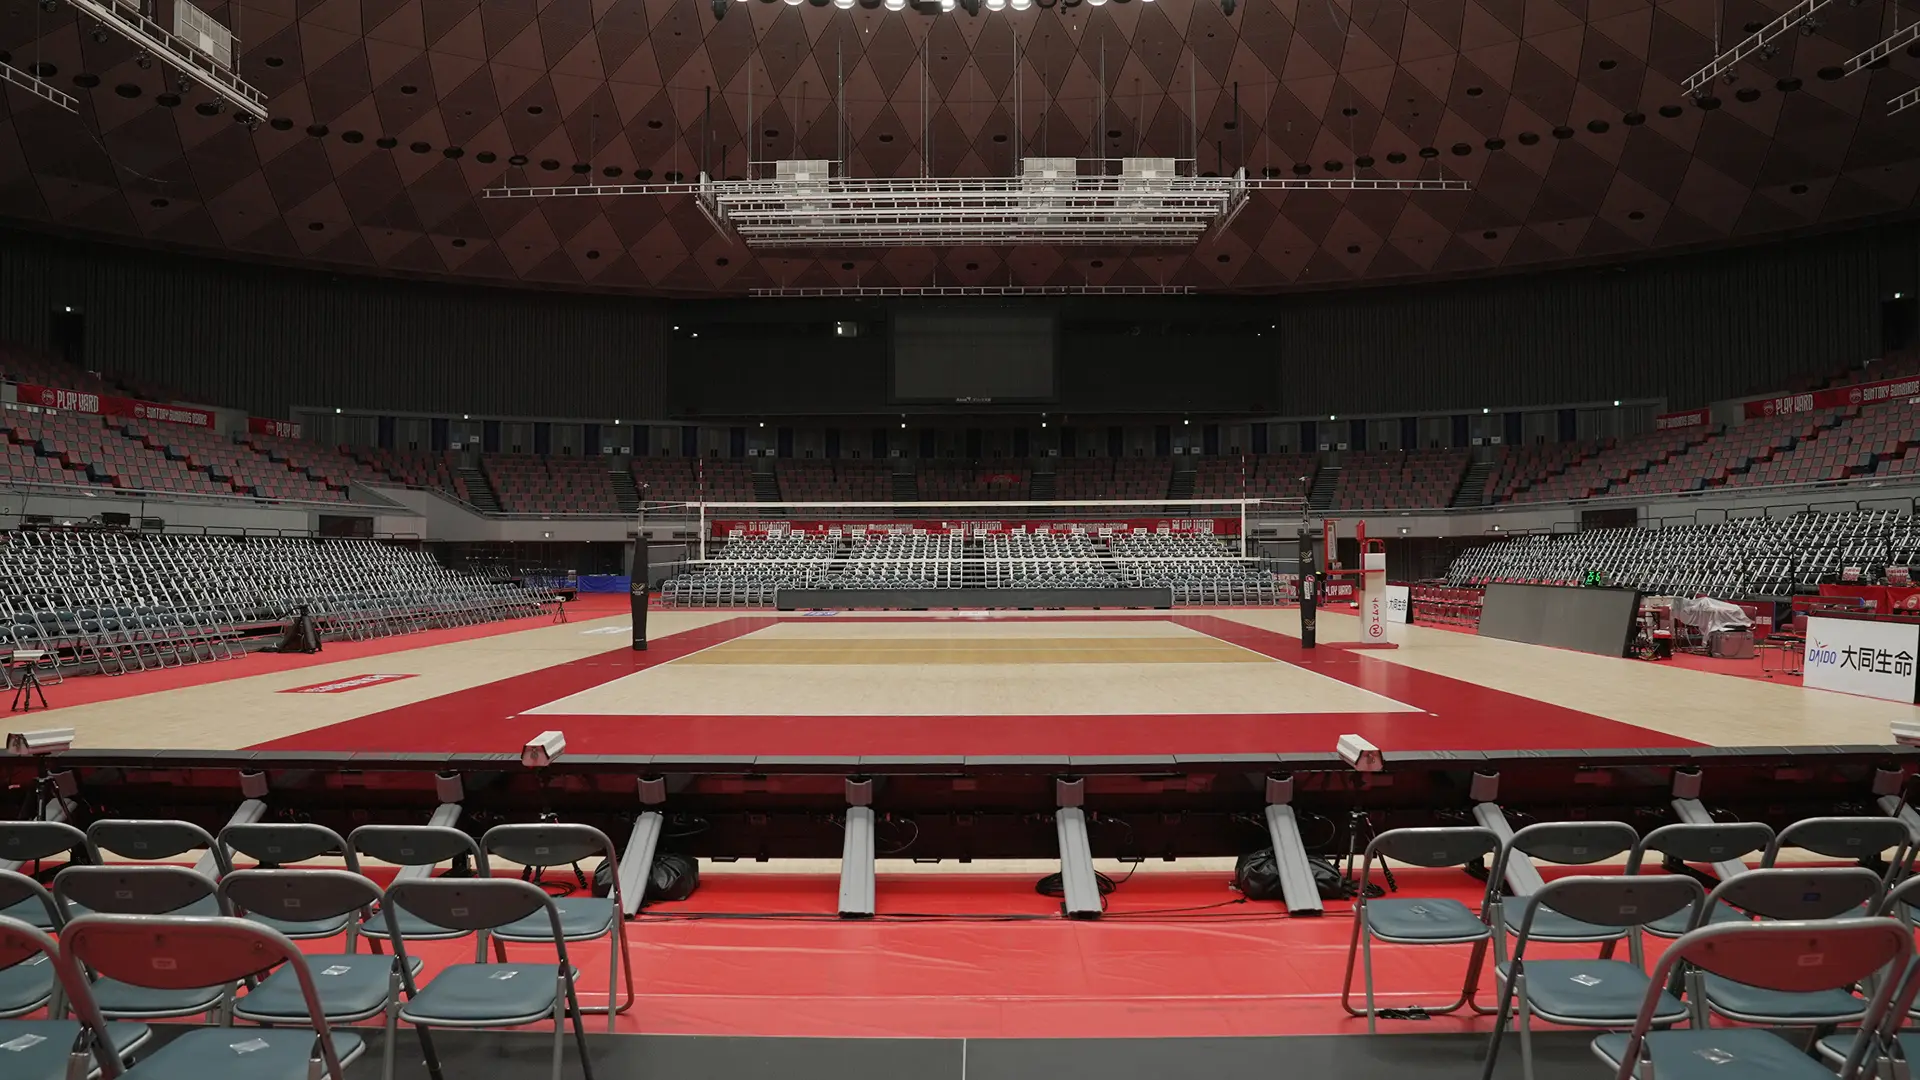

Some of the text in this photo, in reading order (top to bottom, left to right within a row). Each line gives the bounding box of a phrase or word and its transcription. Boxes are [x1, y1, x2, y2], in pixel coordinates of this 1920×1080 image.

[57, 390, 99, 412] PLAY HARD
[1775, 394, 1814, 415] PLAY HARD
[1808, 645, 1914, 677] DAIDO 大同生命
